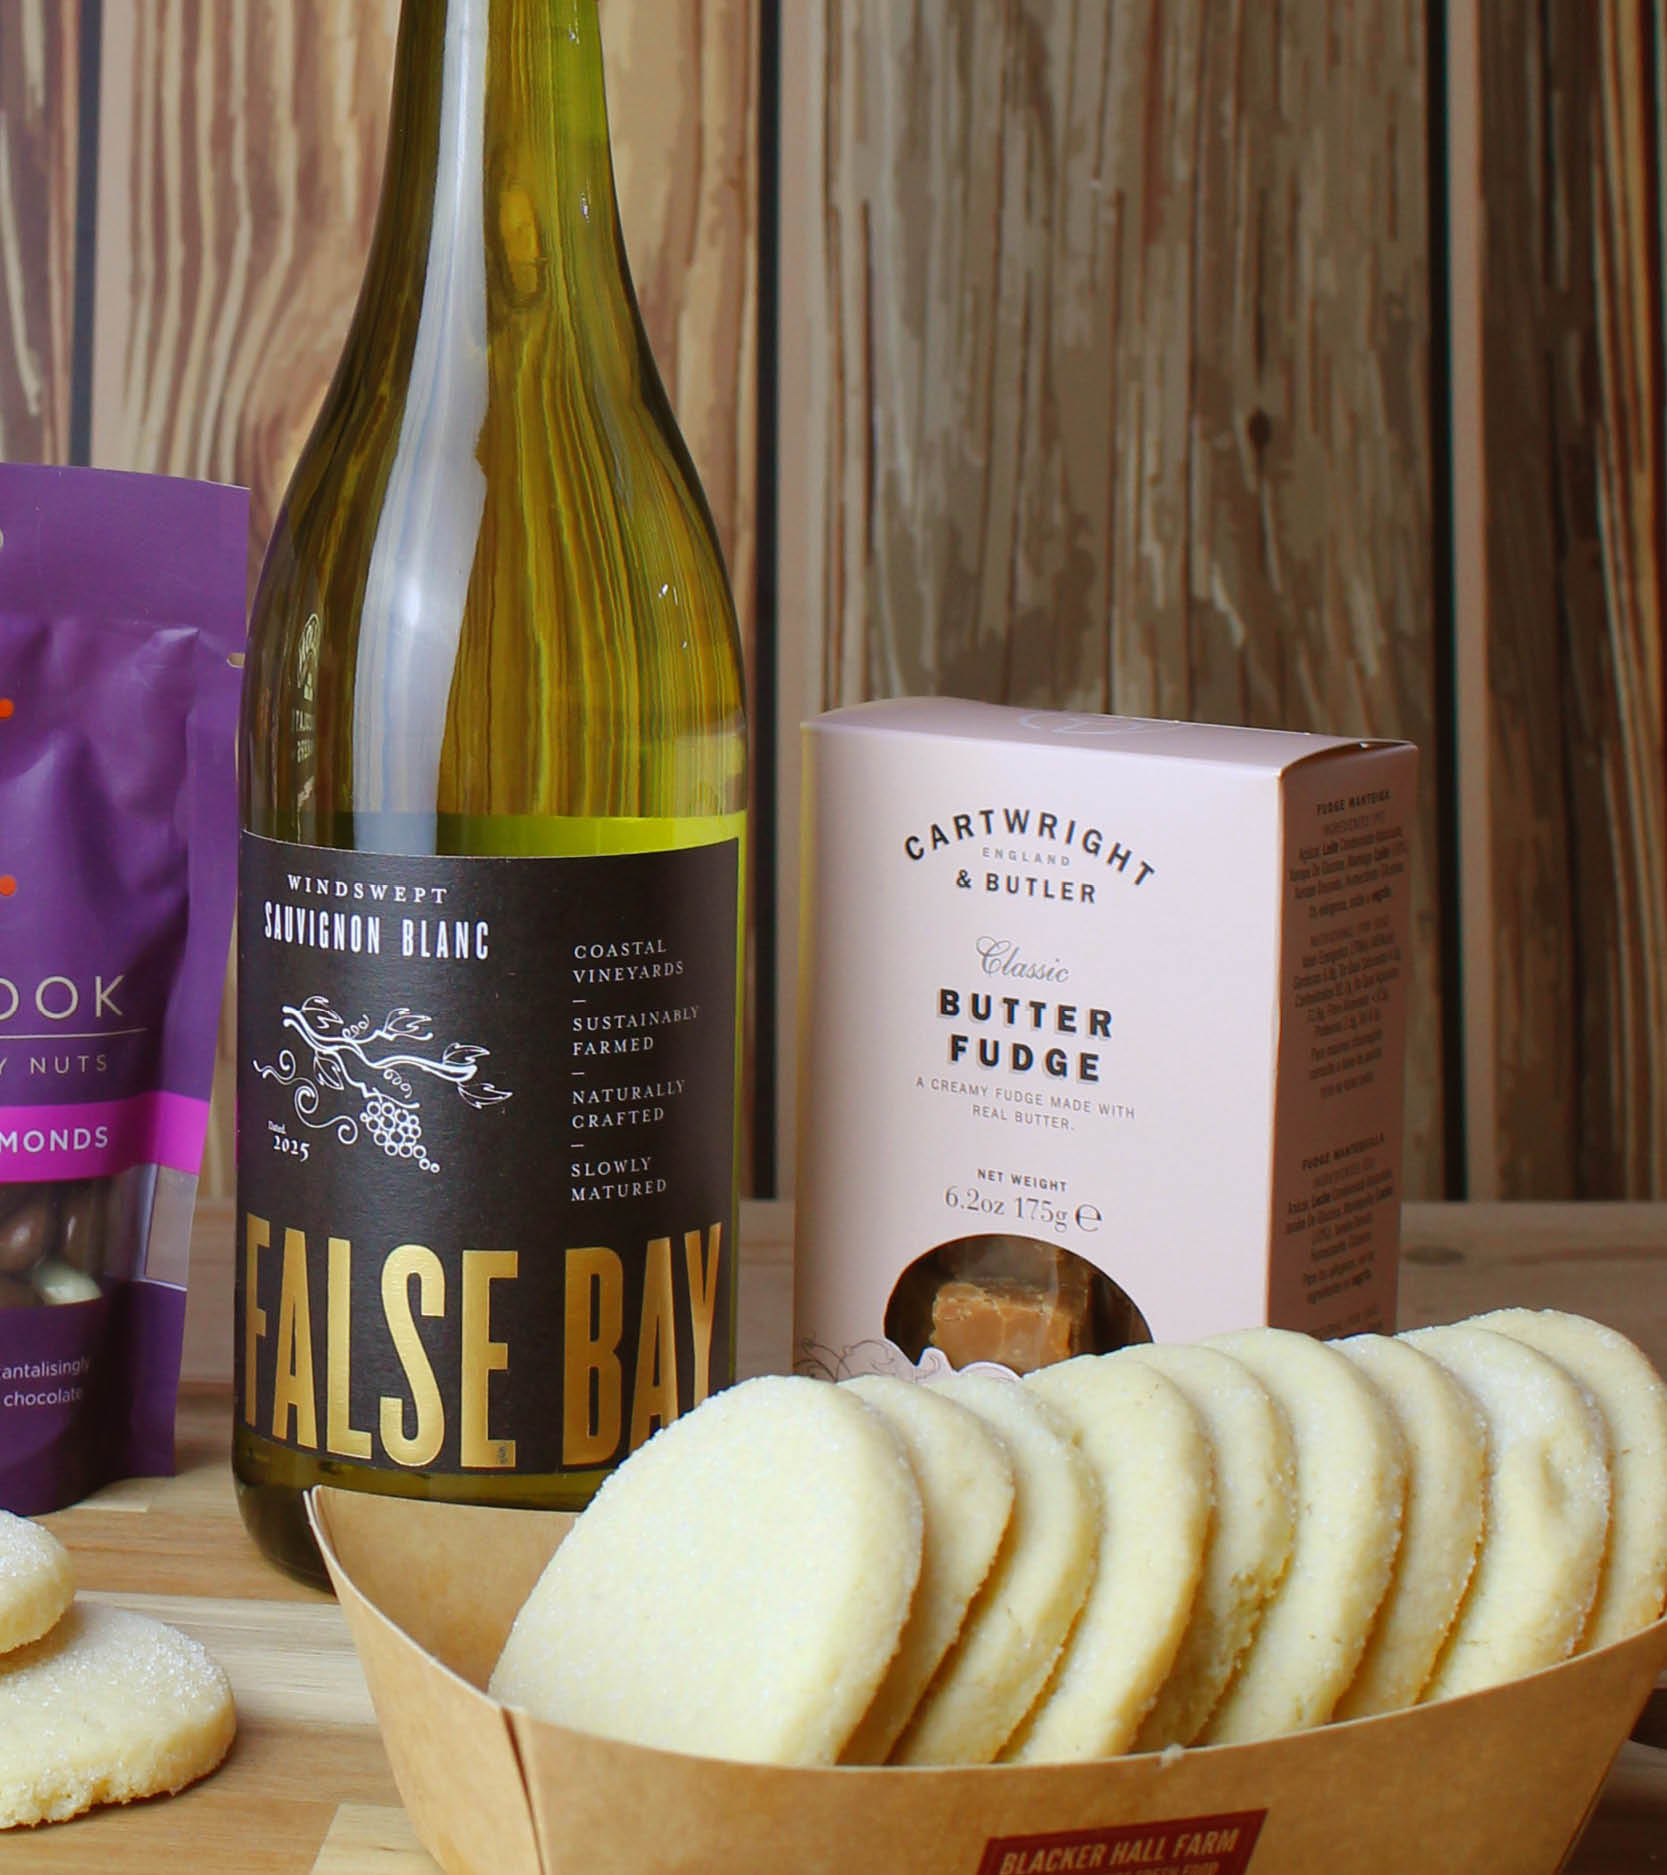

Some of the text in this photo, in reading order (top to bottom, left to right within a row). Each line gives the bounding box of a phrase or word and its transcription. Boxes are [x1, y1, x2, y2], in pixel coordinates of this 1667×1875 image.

[904, 807, 1156, 887] CARTWRIGHT
[982, 847, 1071, 866] ENGLAND
[287, 874, 448, 904] WINDSWEPT
[956, 869, 1097, 904] & BUTLER
[264, 901, 489, 960] SAUVIGNON BLANC
[574, 939, 667, 960] COASTAL
[975, 935, 1070, 984] Classic
[573, 961, 685, 984] VINEYARDS
[573, 1005, 700, 1032] SUSTAINABLY
[938, 988, 1113, 1038] BUTTER
[573, 1036, 655, 1057] FARMED
[951, 1033, 1100, 1082] FUDGE
[30, 1054, 107, 1075] NUTS
[572, 1080, 686, 1105] NATURALLY
[915, 1076, 1136, 1119] A CREAMY FUDGE MADE WITH
[572, 1107, 665, 1129] CRAFTED
[972, 1104, 1076, 1131] REAL BUTTER.
[0, 1125, 108, 1153] MONDS
[273, 1135, 310, 1162] 2025
[571, 1156, 652, 1177] SLOWLY
[571, 1178, 667, 1202] MATURED
[977, 1168, 1068, 1193] NET WEIGHT
[945, 1185, 1006, 1217] 6.2oz
[1014, 1196, 1069, 1234] 175g
[245, 1213, 722, 1468] FALSE BAY
[1001, 1828, 1240, 1875] BLACKER HALL FARM
